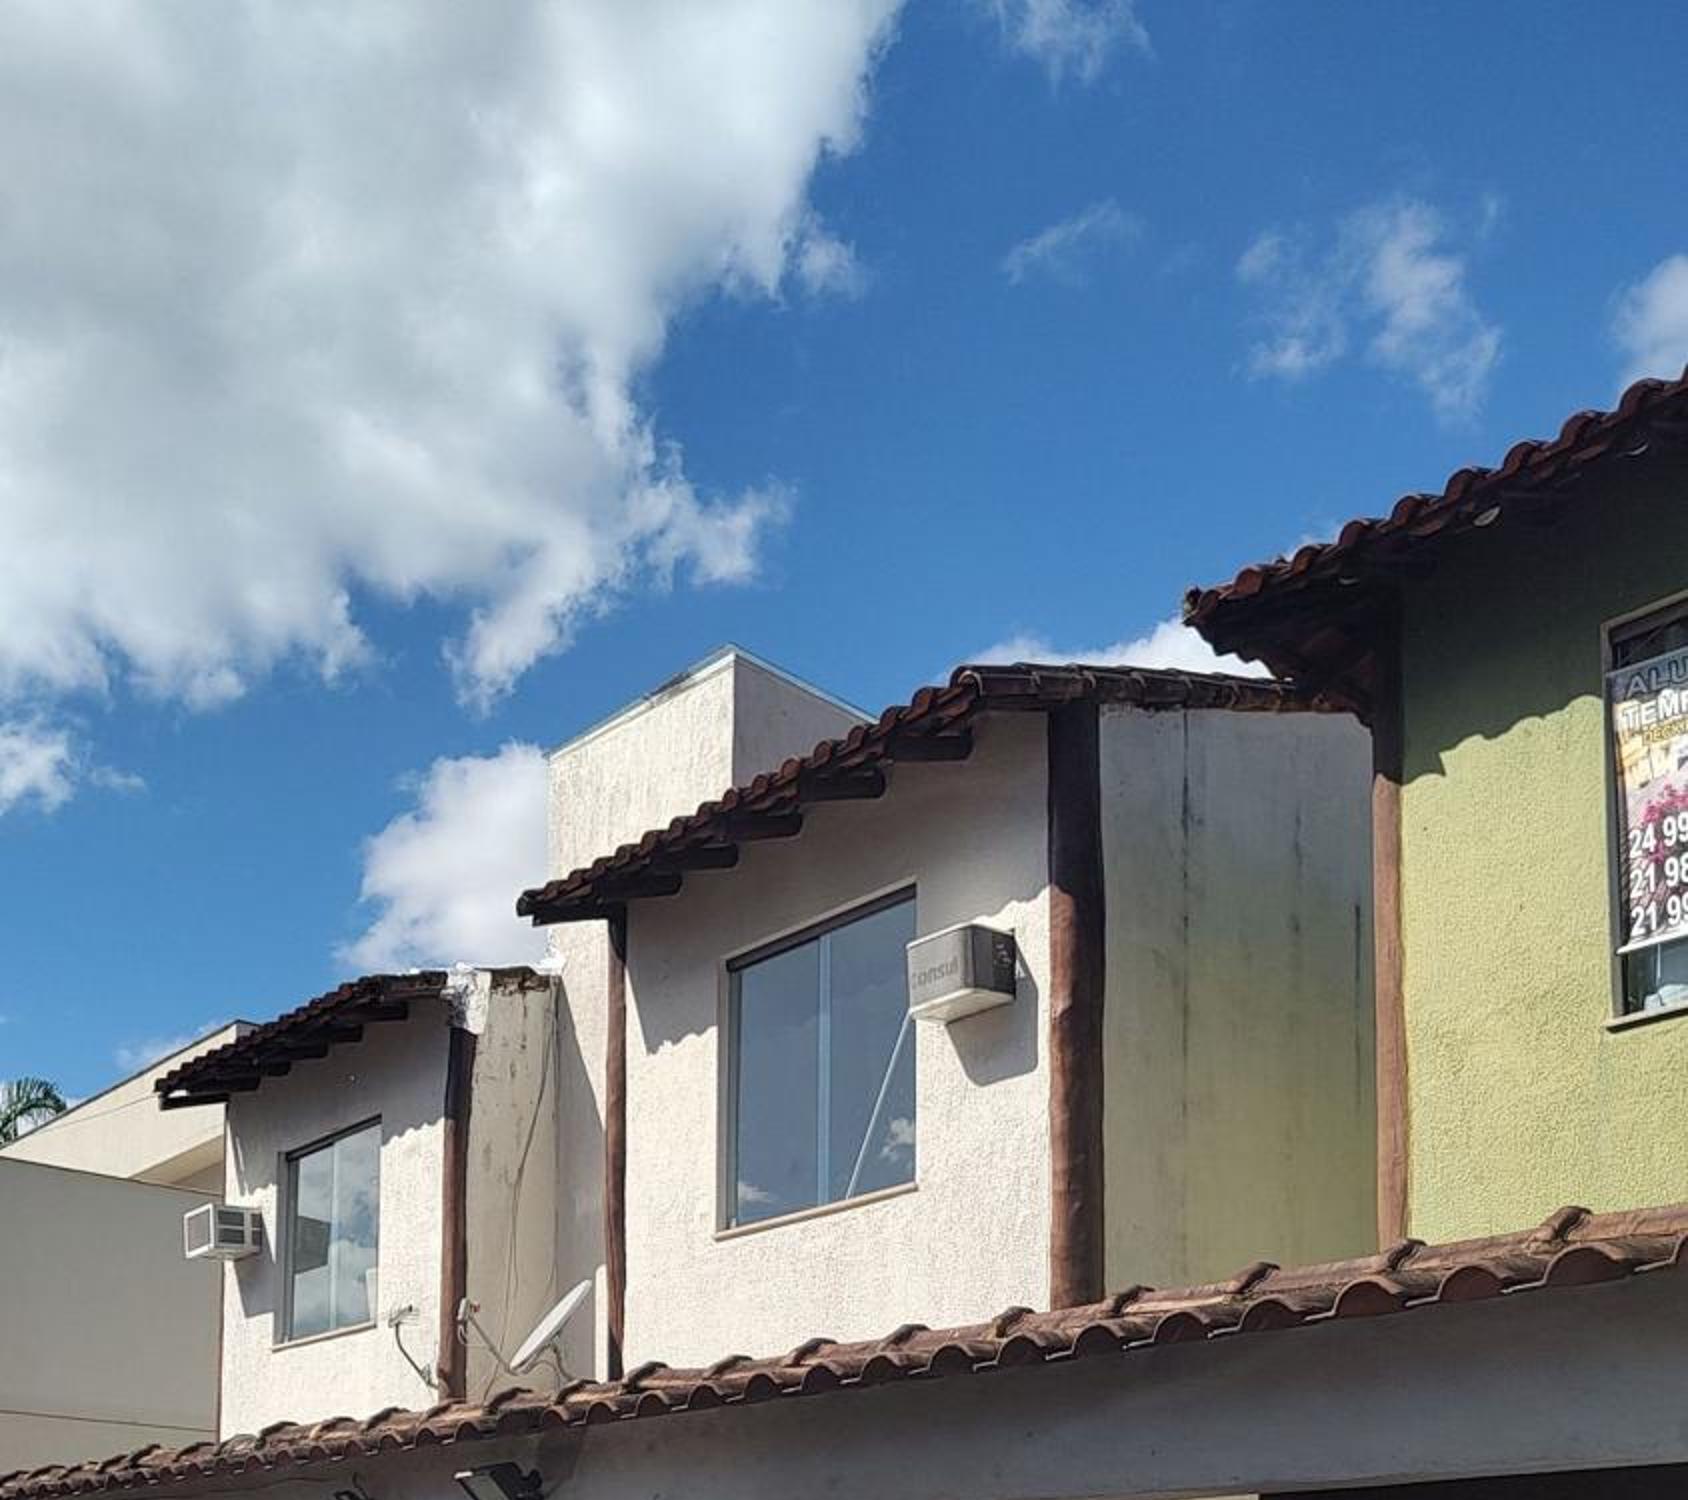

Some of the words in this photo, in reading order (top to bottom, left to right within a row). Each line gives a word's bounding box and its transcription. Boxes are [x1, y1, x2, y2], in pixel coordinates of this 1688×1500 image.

[1628, 822, 1657, 859] 24
[1662, 811, 1688, 847] 99
[1629, 862, 1656, 899] 21
[1630, 900, 1657, 937] 21
